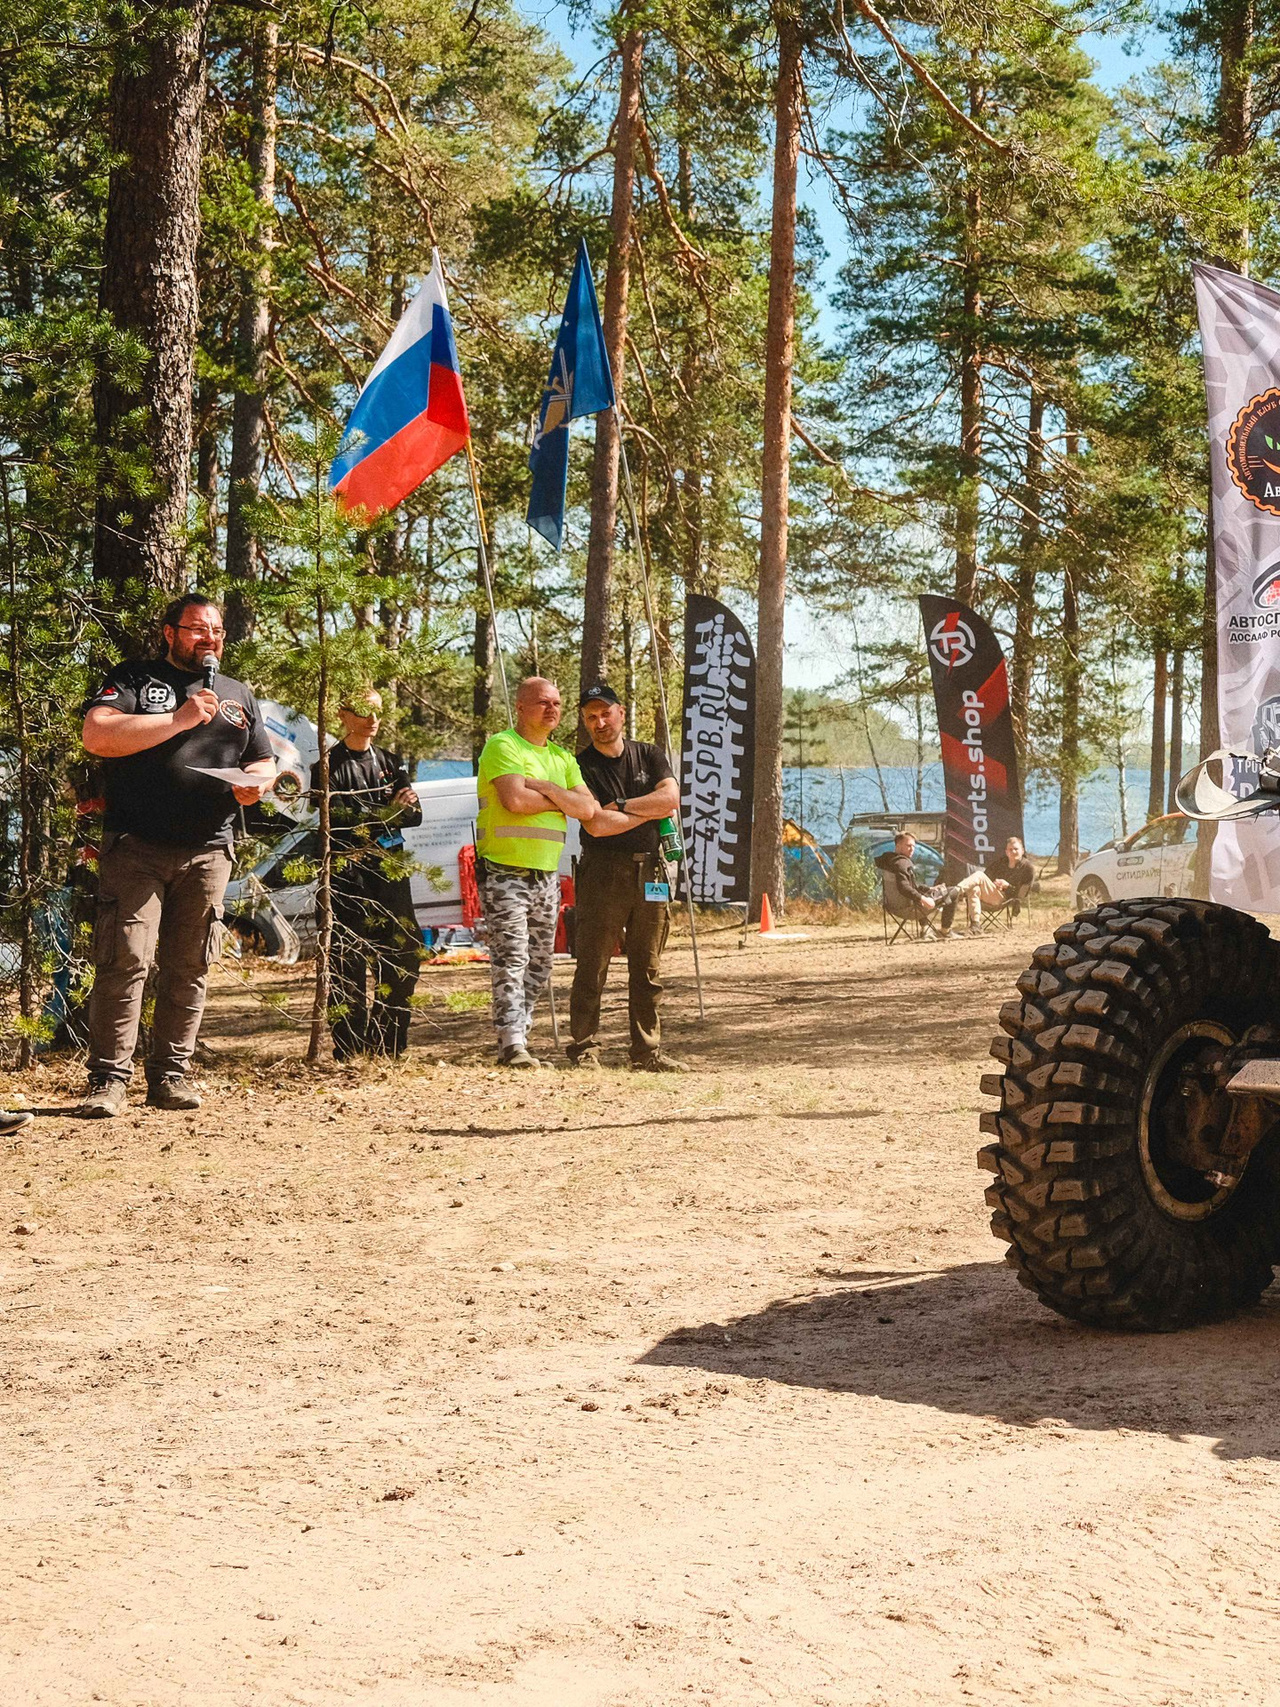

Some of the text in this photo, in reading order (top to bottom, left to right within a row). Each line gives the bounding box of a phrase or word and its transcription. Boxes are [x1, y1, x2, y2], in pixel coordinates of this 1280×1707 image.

[1257, 402, 1277, 416] КЛУБ
[1230, 631, 1268, 642] ДОСААФ
[695, 684, 727, 843] 4X4SPB.RU
[1116, 867, 1161, 880] СИТИДРАЙВ
